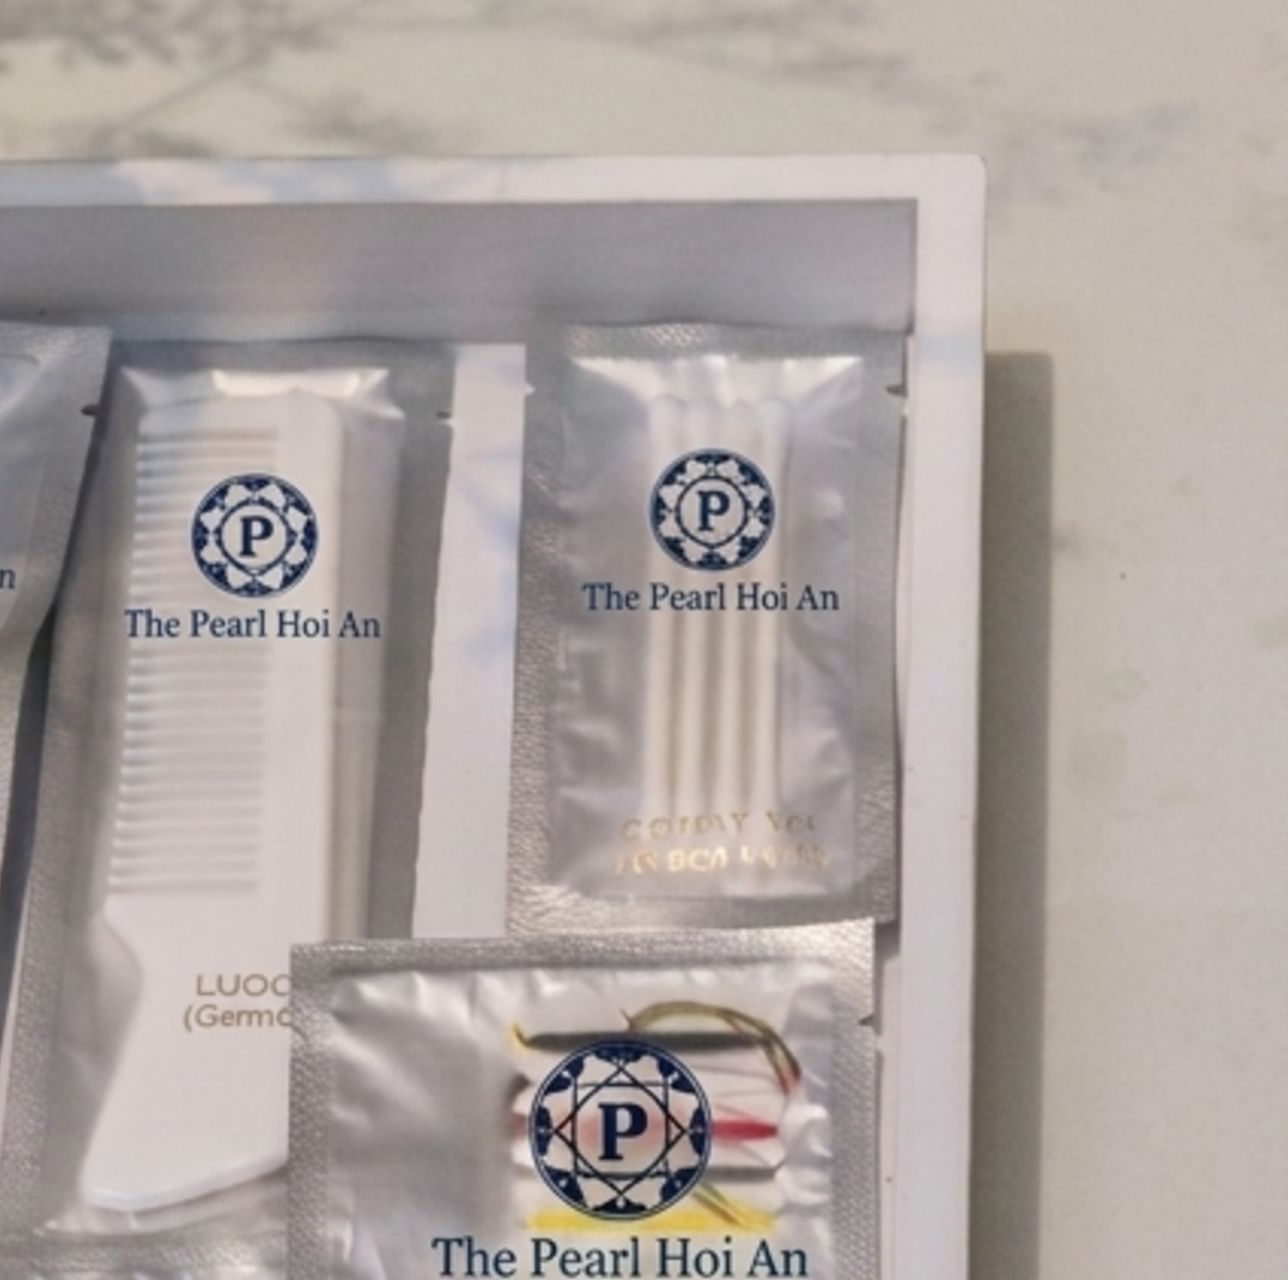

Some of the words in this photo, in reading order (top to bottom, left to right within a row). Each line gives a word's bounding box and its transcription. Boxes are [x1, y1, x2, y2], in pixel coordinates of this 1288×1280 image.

[697, 489, 730, 533] P
[239, 515, 274, 558] P
[582, 582, 640, 611] The
[650, 582, 726, 612] Pearl
[737, 582, 788, 611] Hoi
[795, 584, 840, 611] An
[125, 608, 181, 638] The
[190, 608, 267, 638] Pearl
[276, 608, 330, 638] Hoi
[338, 611, 381, 638] An
[597, 1102, 649, 1162] P
[431, 1235, 517, 1279] The
[530, 1235, 642, 1279] Pearl
[655, 1235, 735, 1279] Hoi
[746, 1238, 809, 1279] An
